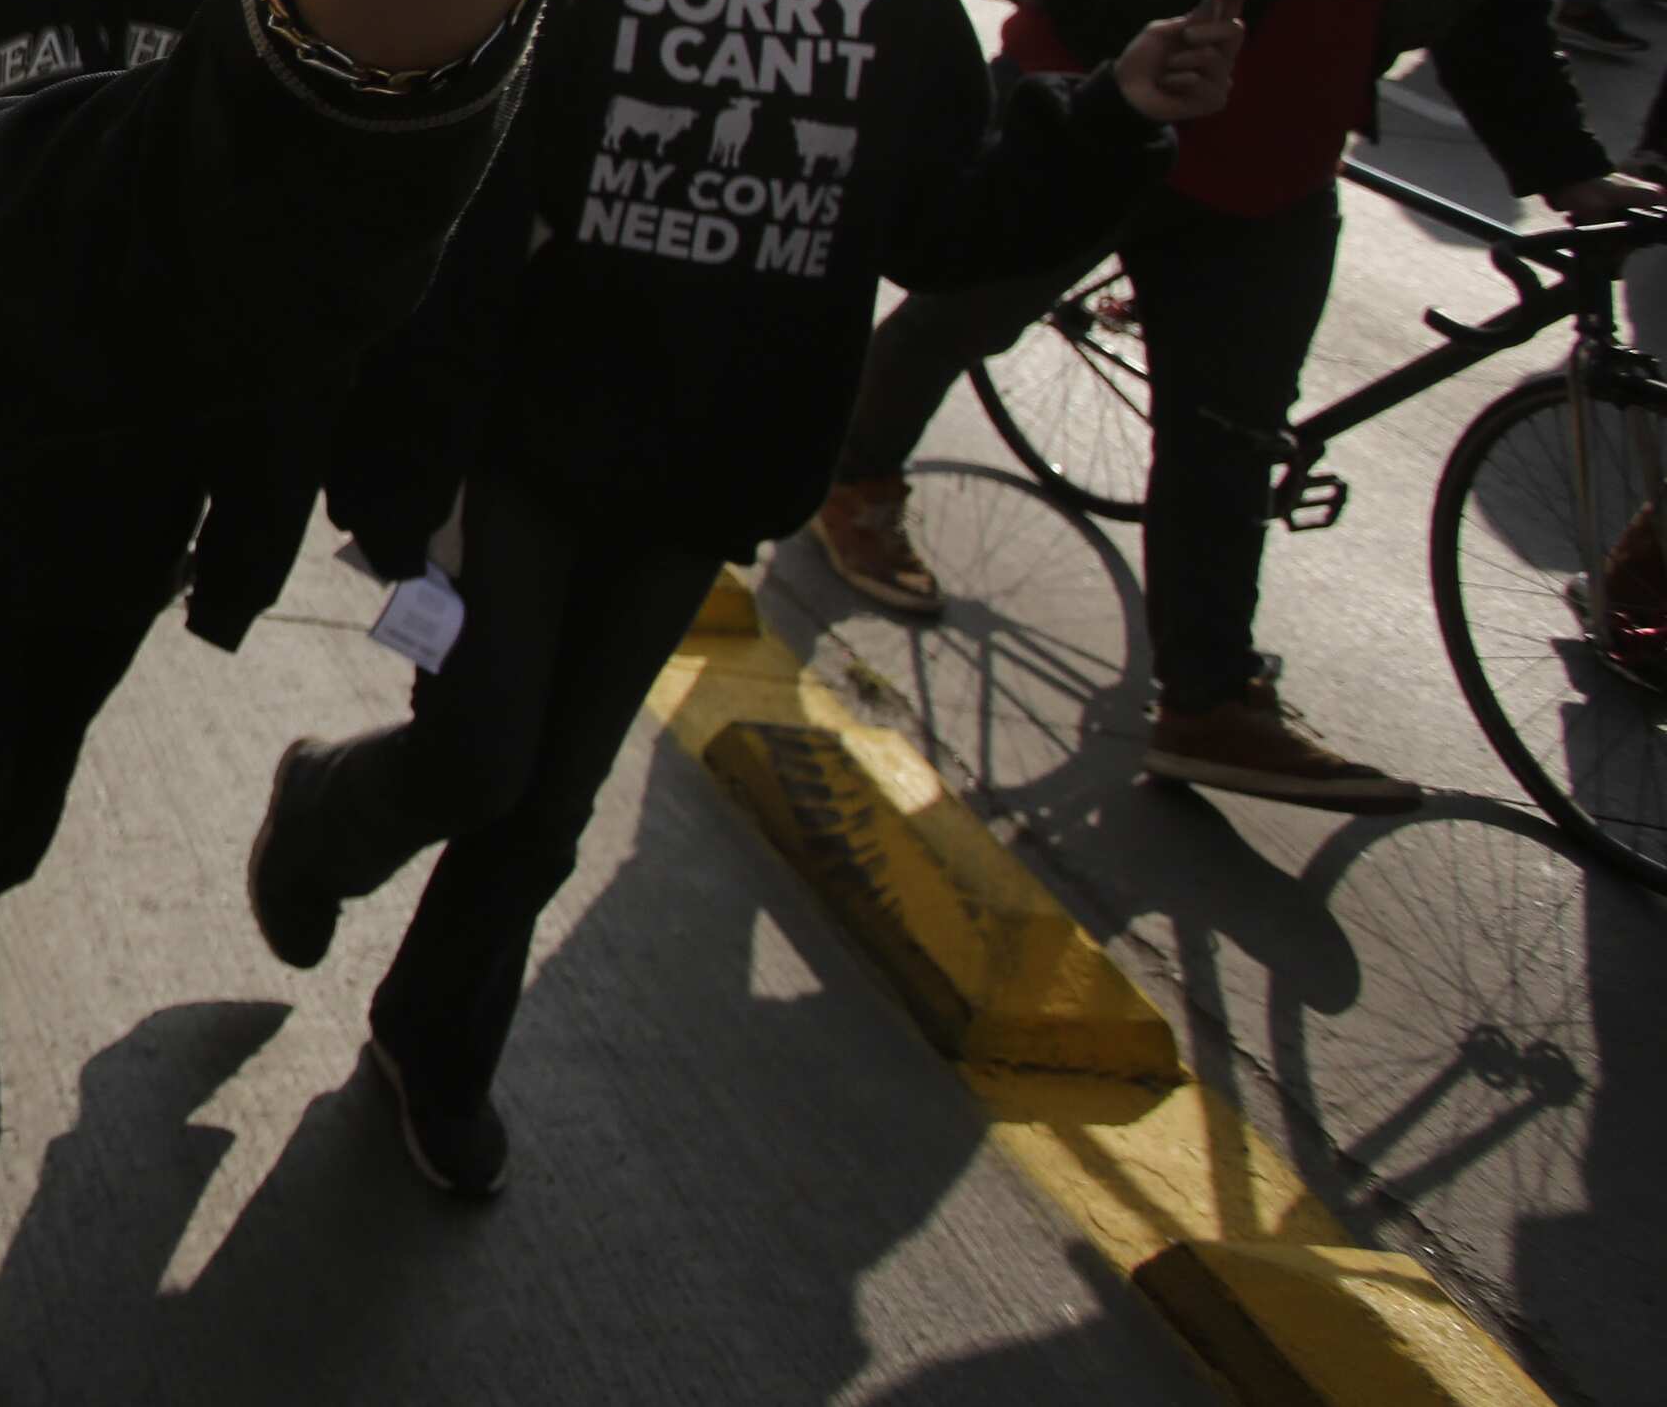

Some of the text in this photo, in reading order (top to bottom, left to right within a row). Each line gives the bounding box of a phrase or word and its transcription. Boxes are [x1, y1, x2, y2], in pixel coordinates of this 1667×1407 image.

[613, 17, 876, 101] I CAN'T
[589, 152, 844, 225] MY COWS
[577, 196, 833, 278] NEED ME
